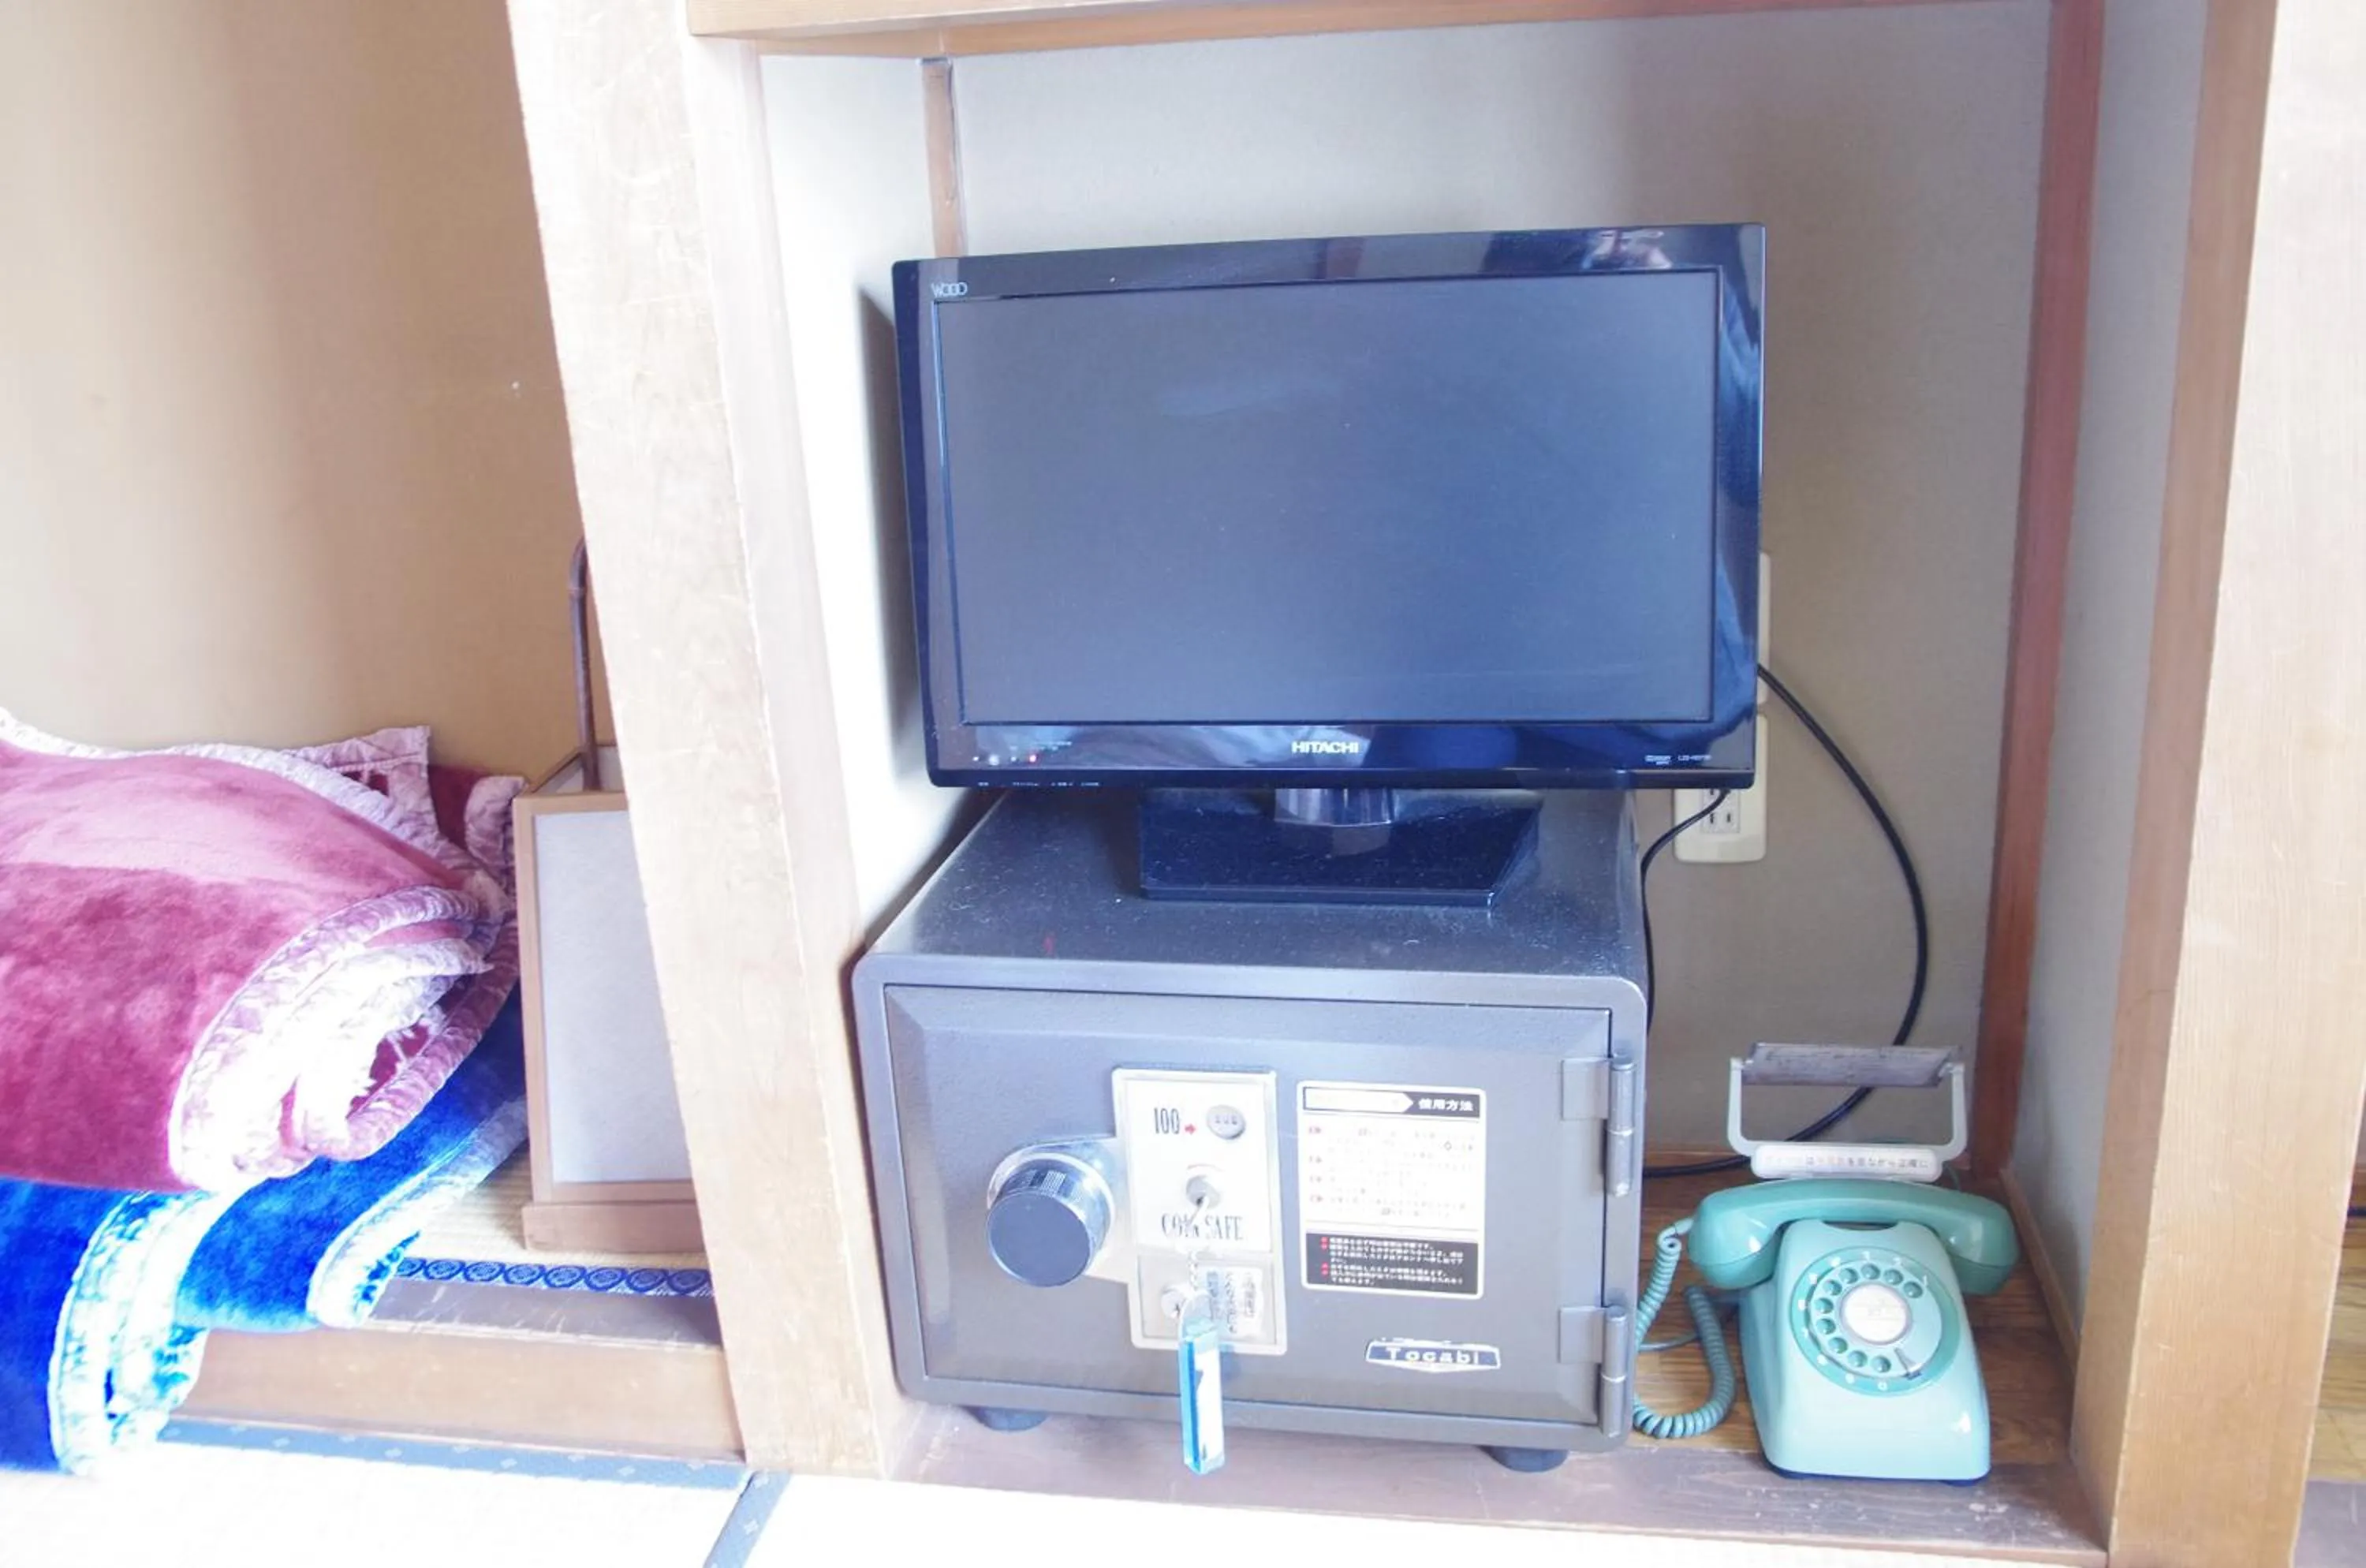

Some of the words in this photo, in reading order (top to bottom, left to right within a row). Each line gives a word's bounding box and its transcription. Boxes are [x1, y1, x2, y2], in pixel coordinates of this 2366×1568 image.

[1291, 741, 1359, 754] HITACHI
[1153, 1107, 1180, 1135] 100
[1204, 1214, 1245, 1241] SAFE
